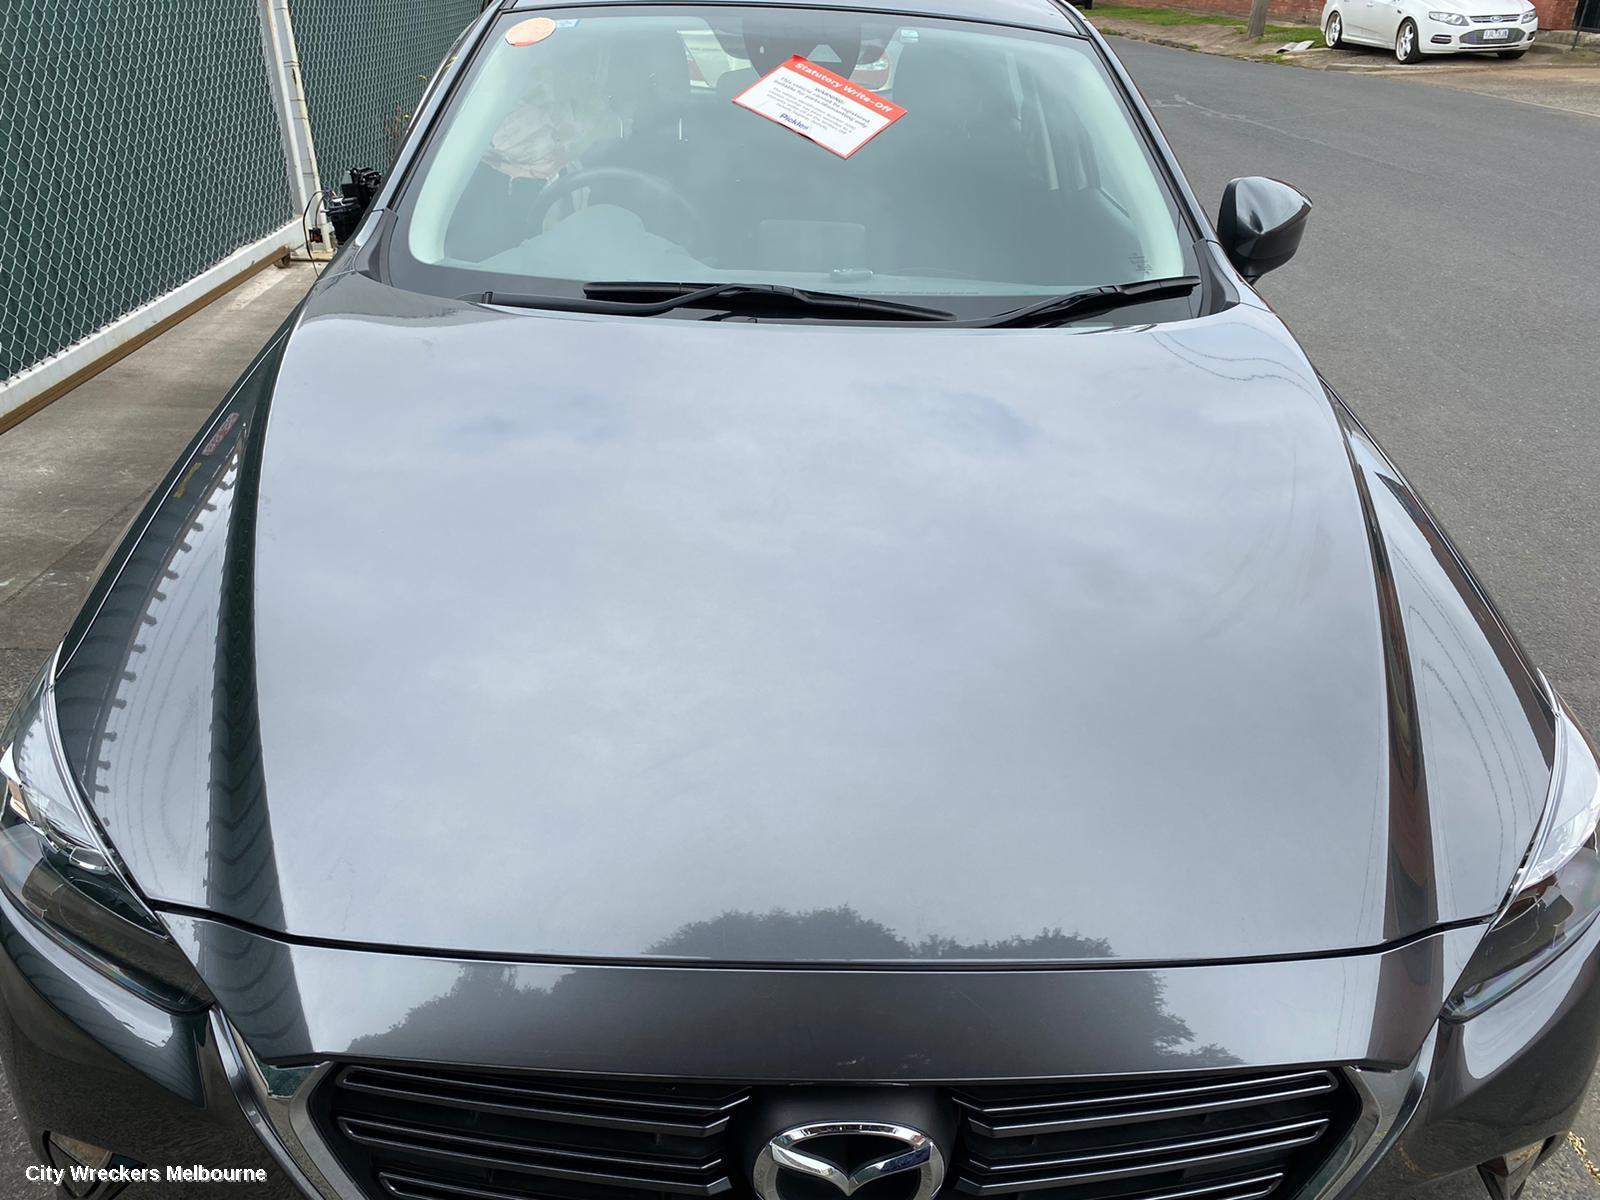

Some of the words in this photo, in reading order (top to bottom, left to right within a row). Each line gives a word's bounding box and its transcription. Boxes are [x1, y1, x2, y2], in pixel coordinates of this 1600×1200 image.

[795, 62, 843, 88] Statutory
[843, 85, 893, 113] Write-Off
[779, 112, 810, 130] Pickles
